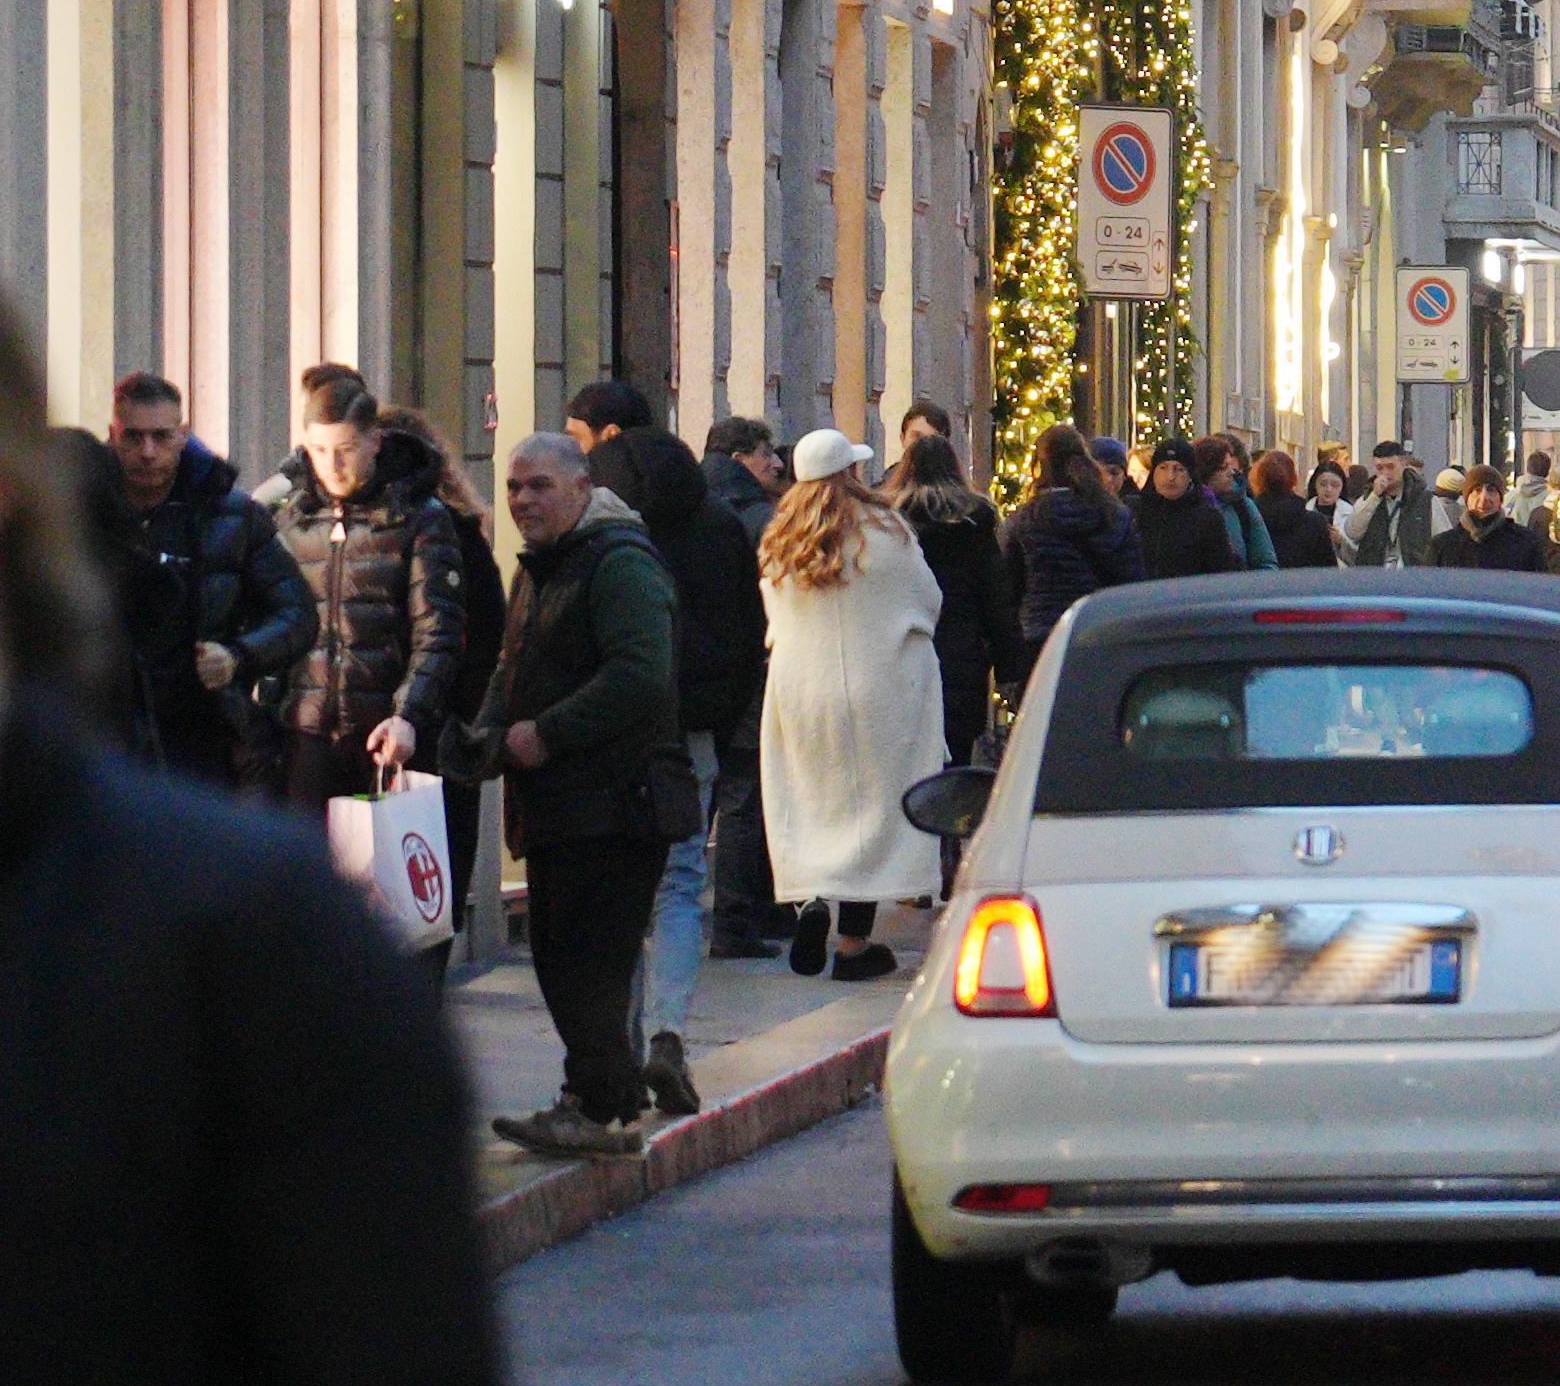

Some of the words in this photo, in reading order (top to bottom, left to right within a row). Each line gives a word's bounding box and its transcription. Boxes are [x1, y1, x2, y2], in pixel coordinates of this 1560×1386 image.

[1104, 225, 1112, 238] 0
[1125, 225, 1143, 239] 24
[1423, 338, 1437, 347] 24
